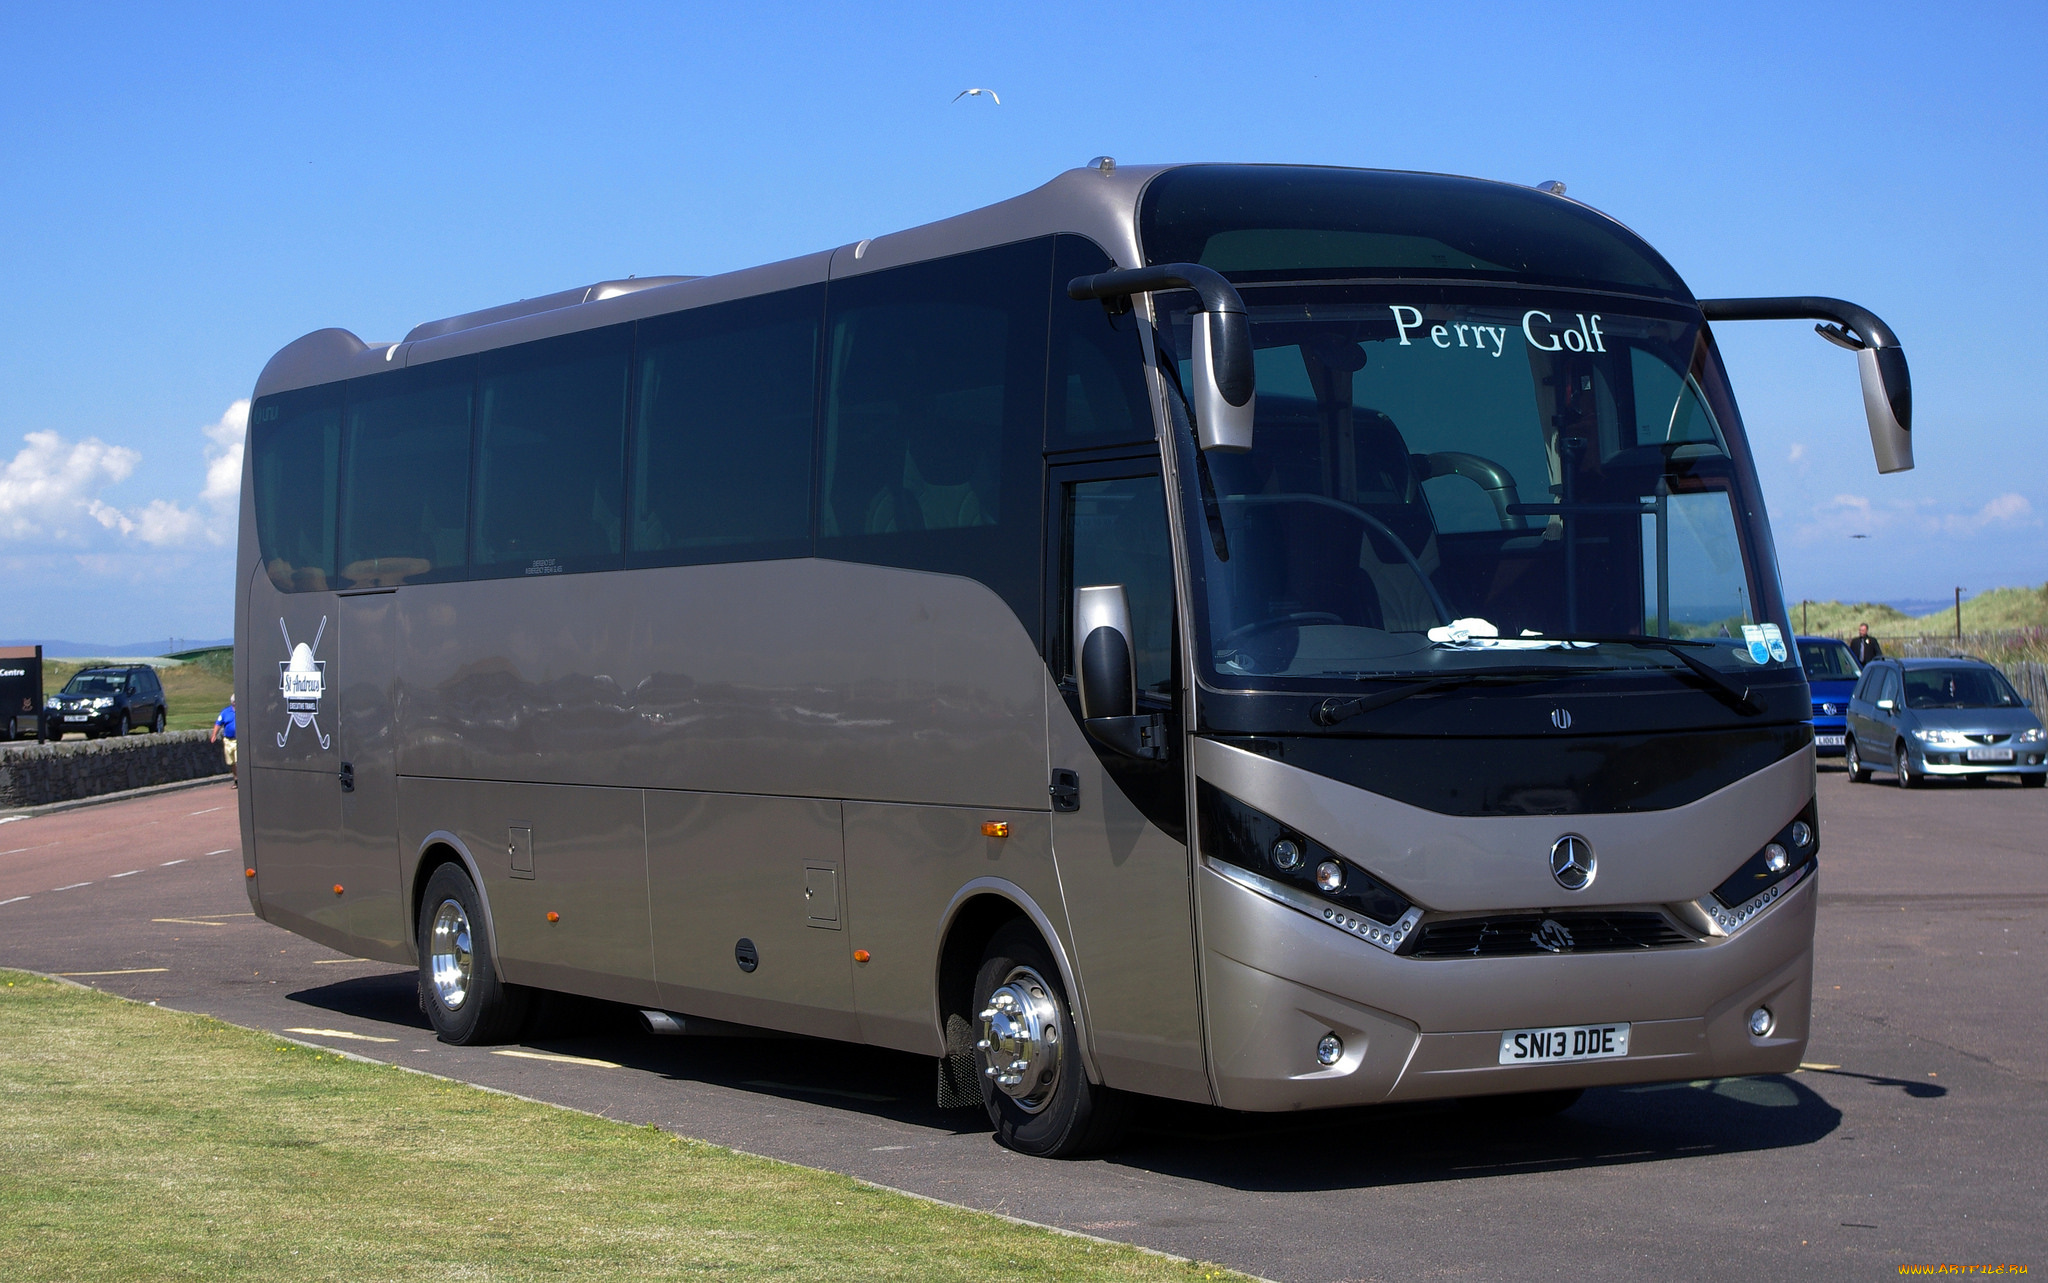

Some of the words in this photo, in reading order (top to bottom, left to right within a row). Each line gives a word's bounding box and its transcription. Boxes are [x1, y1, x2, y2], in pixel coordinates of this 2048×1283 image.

[1389, 305, 1506, 358] Perry
[1522, 309, 1607, 353] Golf
[292, 674, 320, 694] Andrews
[1514, 1032, 1567, 1058] SN13
[1573, 1027, 1616, 1055] DDE
